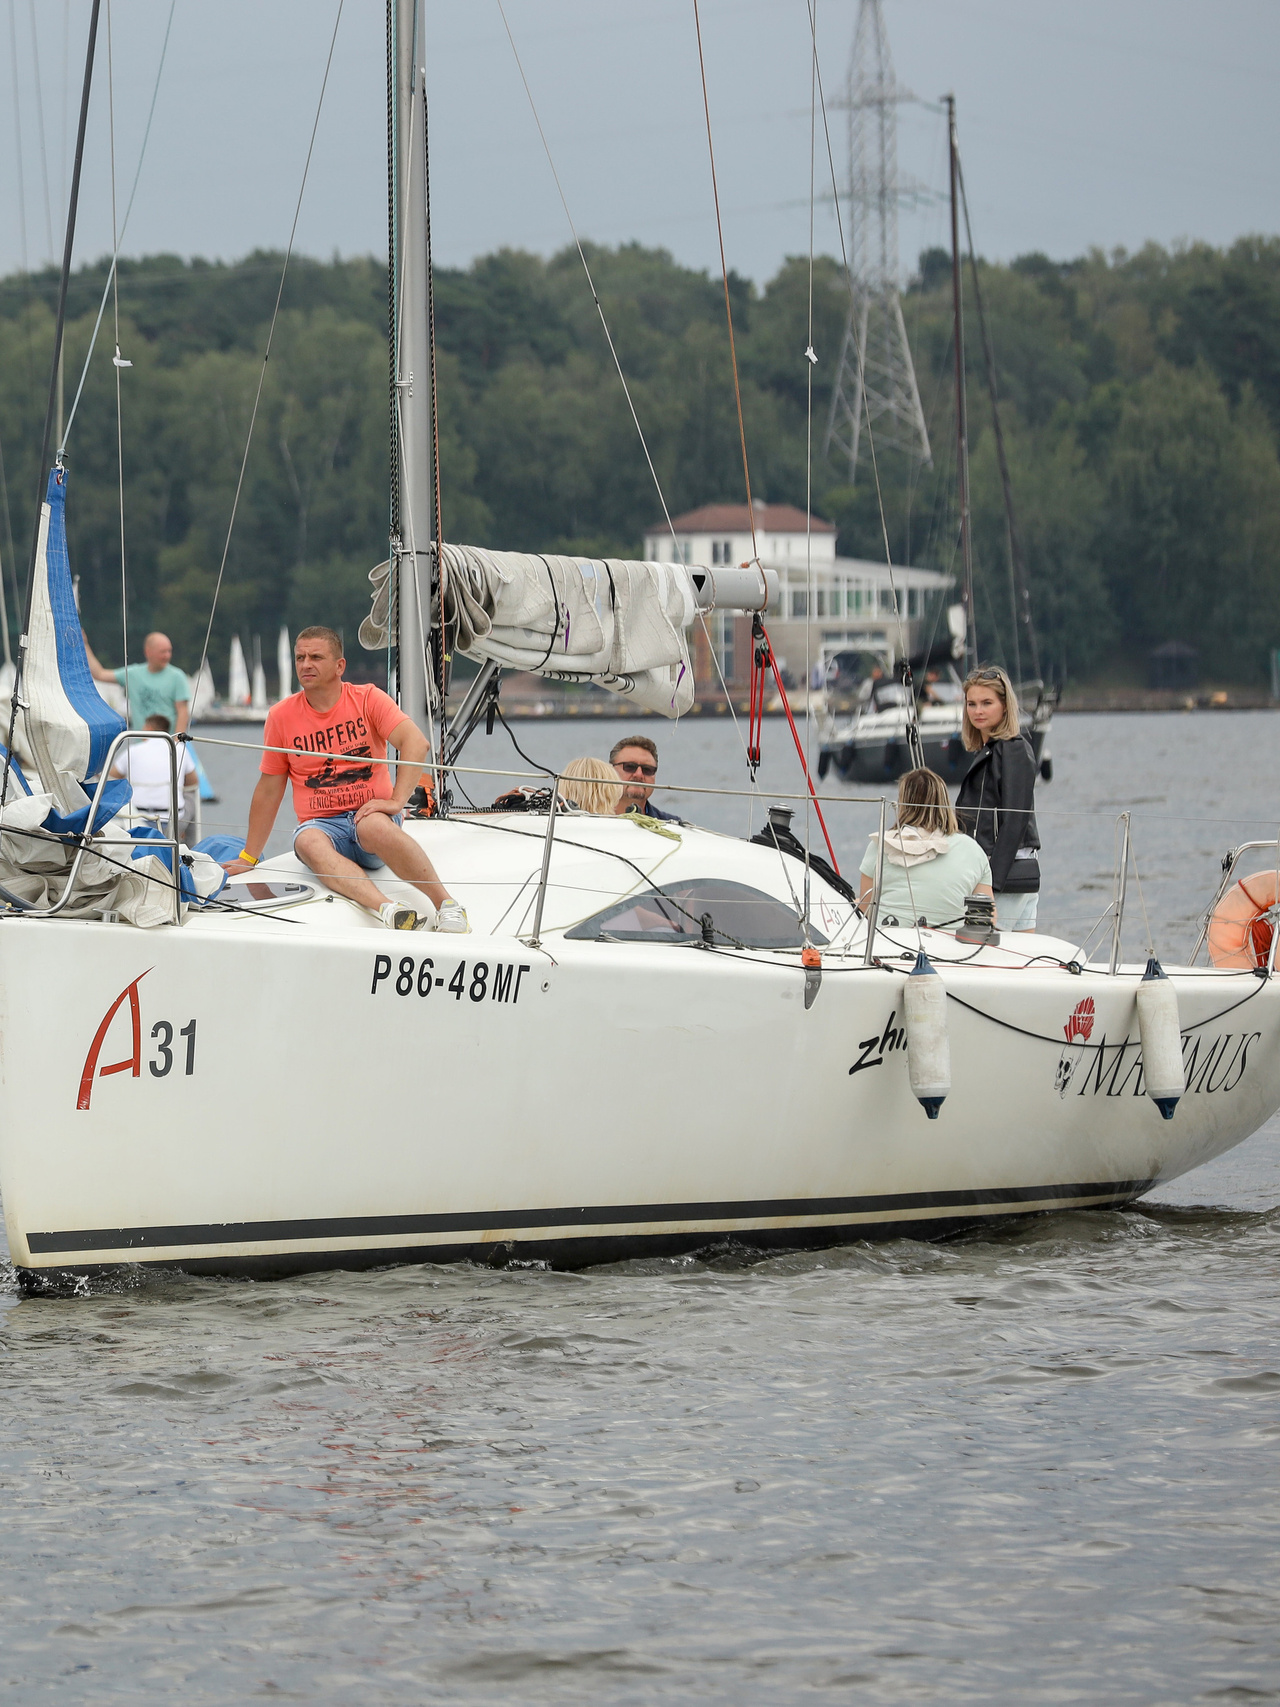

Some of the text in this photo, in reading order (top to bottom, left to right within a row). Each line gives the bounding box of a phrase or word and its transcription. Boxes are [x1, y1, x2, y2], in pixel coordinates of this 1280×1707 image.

[293, 717, 368, 757] SURFERS
[308, 795, 335, 810] VENICE
[336, 791, 364, 807] BEACH
[1077, 1032, 1262, 1097] MAMUS
